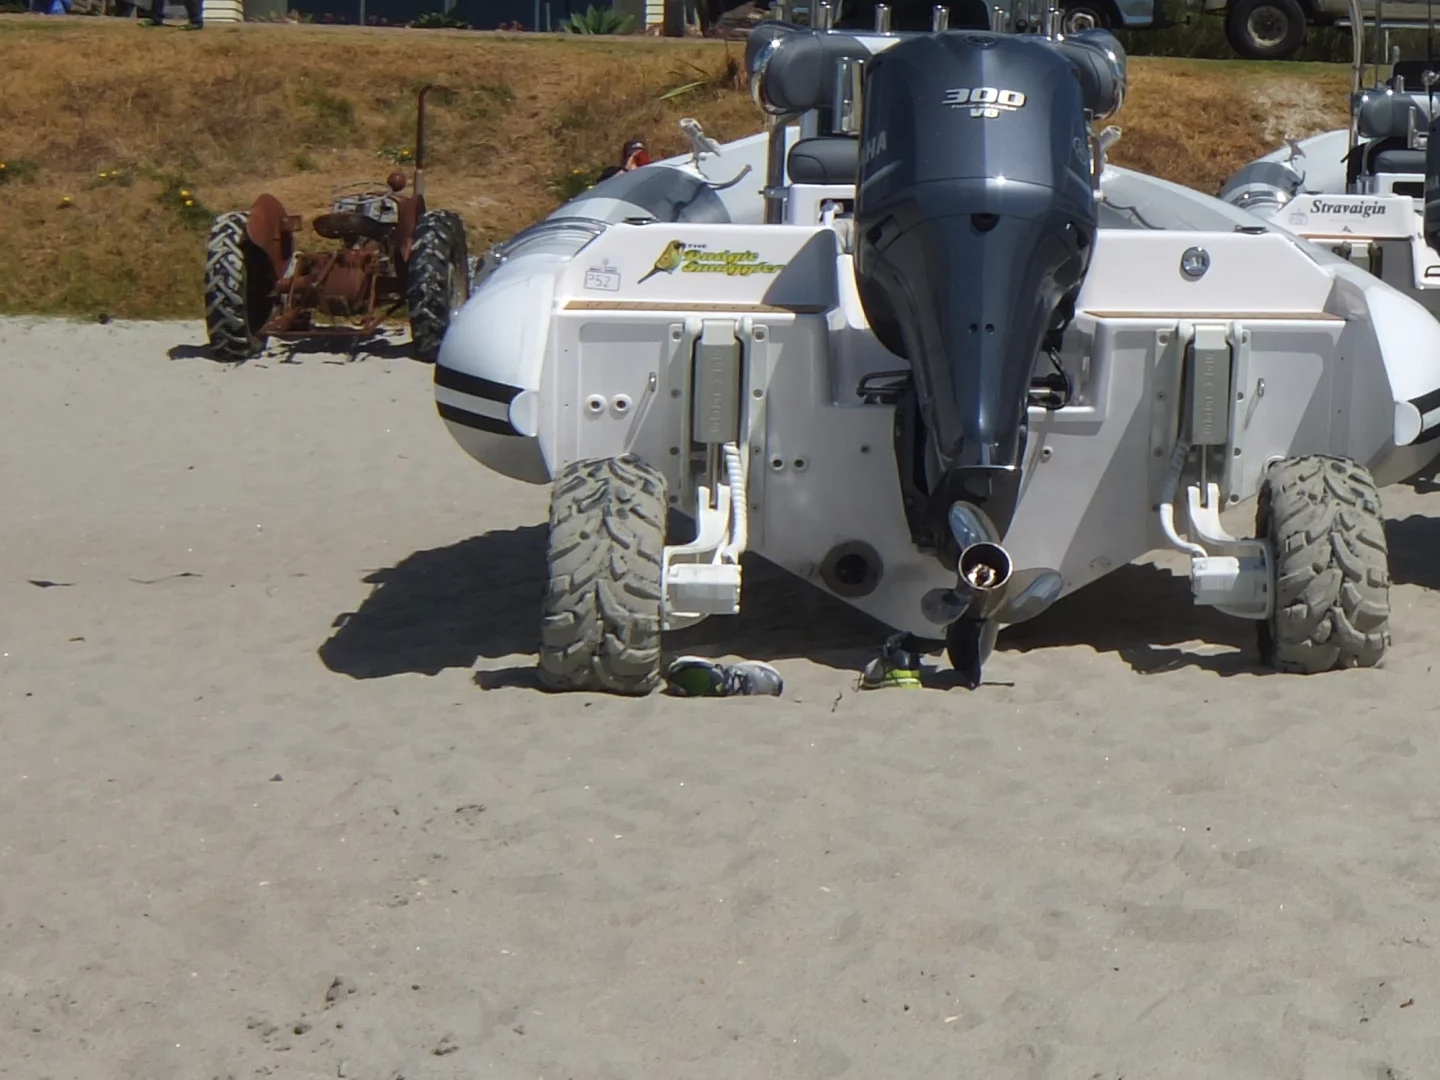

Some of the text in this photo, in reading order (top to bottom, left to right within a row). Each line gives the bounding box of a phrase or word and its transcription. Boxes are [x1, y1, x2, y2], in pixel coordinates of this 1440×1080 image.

[941, 86, 1026, 107] 300
[970, 107, 999, 118] V6
[1310, 199, 1387, 218] Stravaigin
